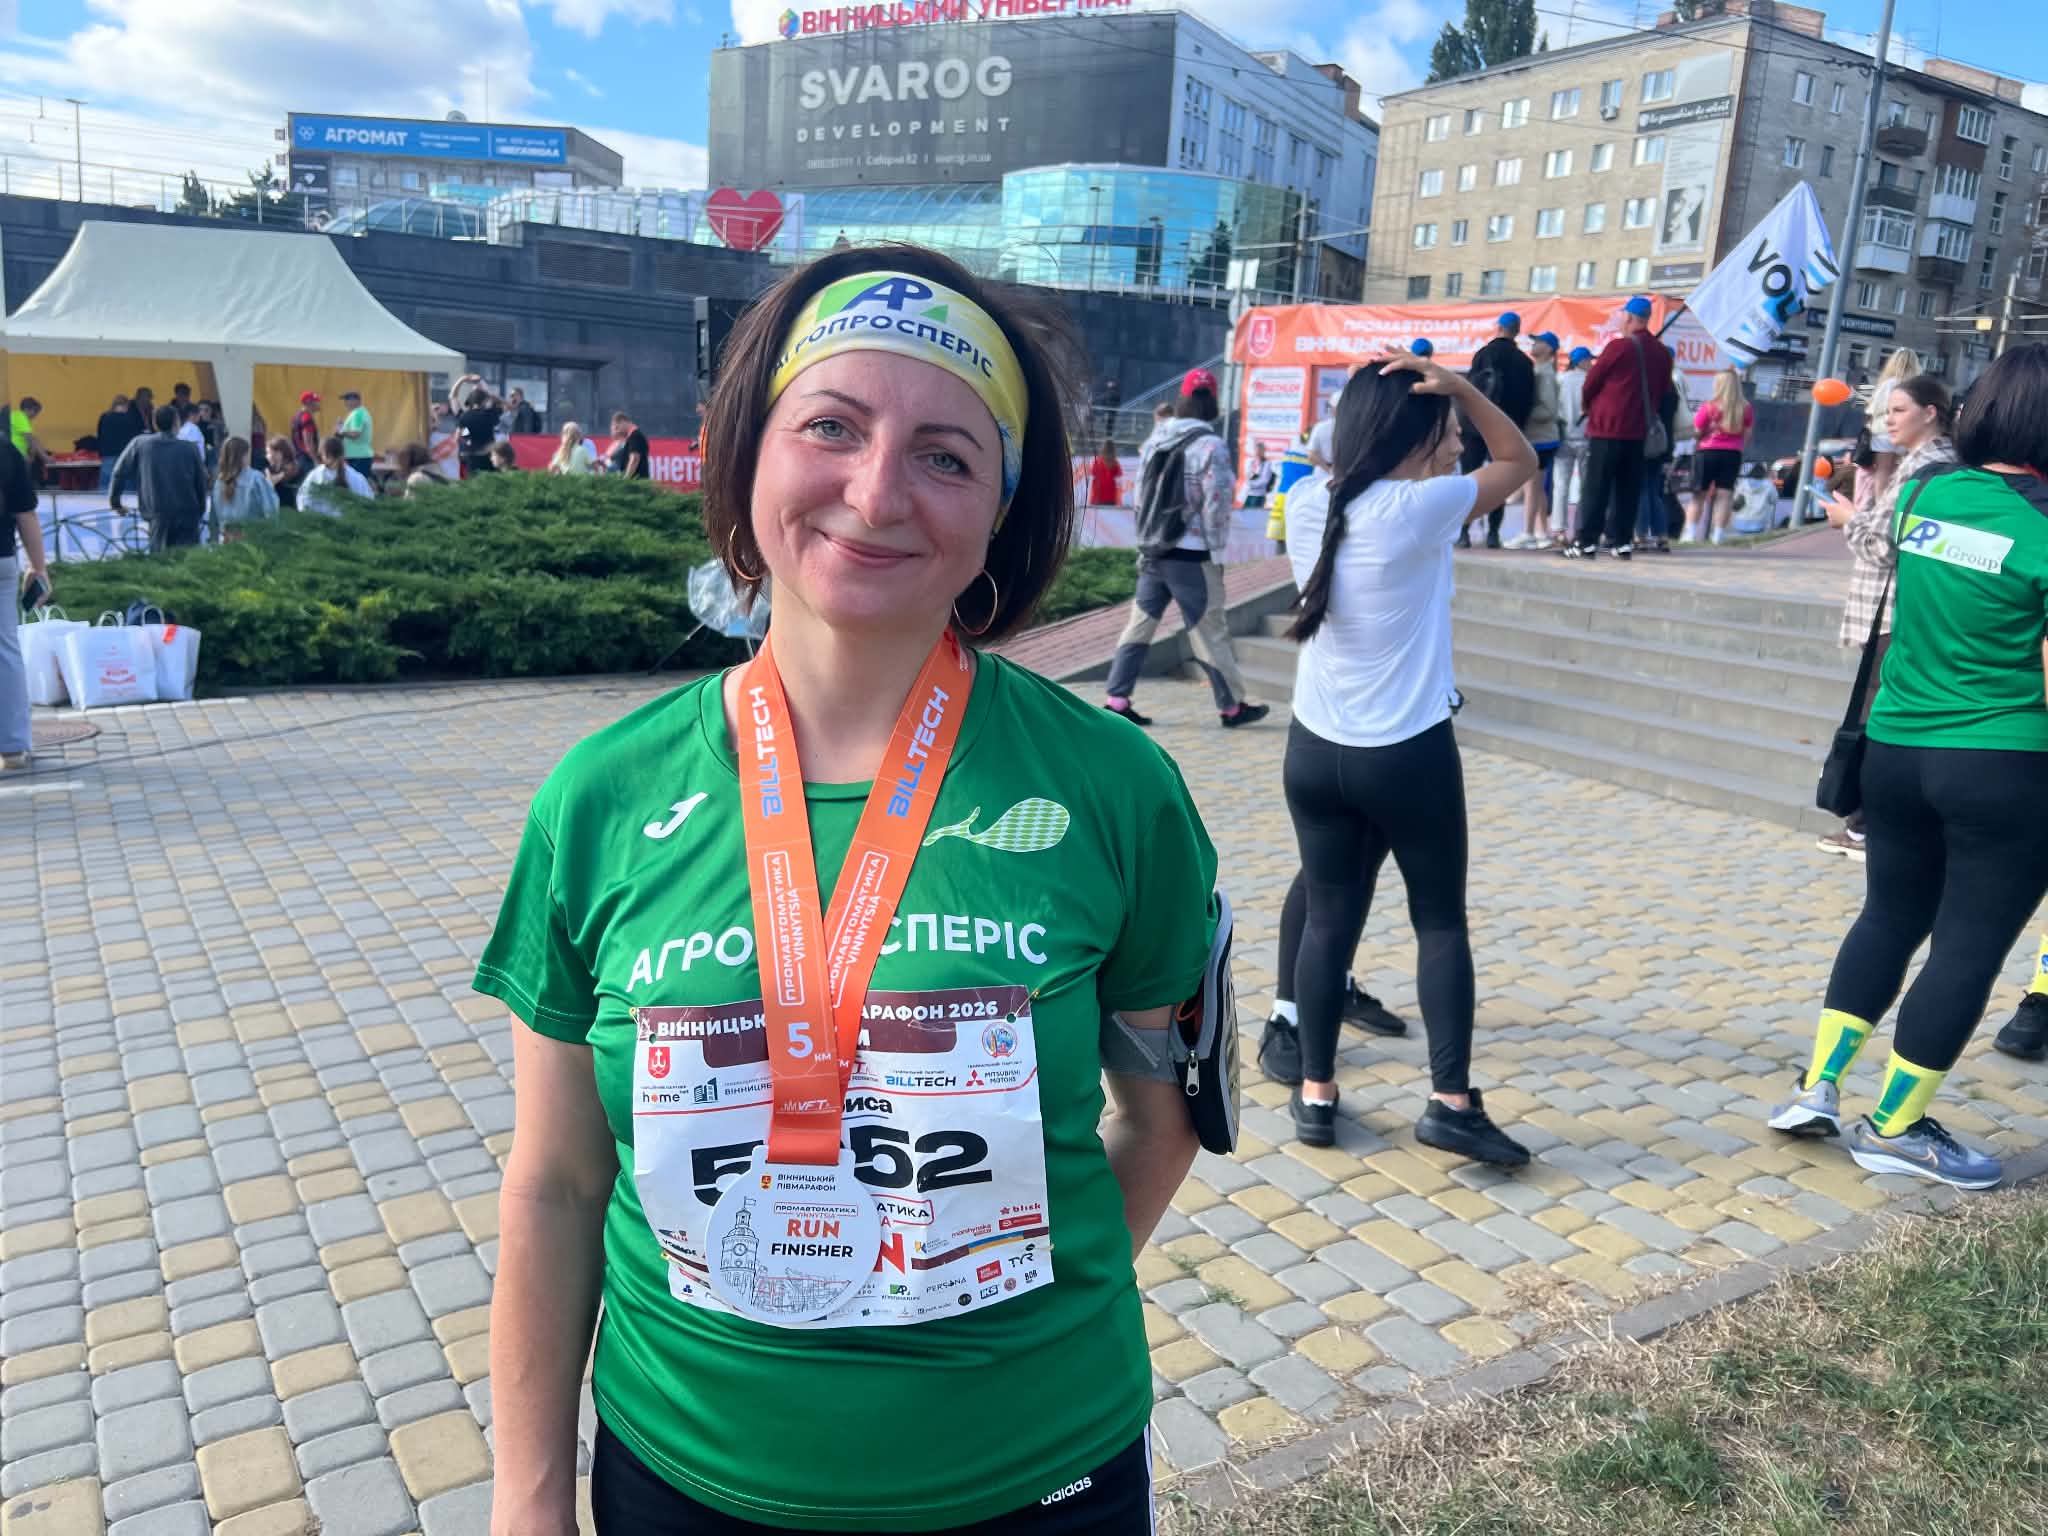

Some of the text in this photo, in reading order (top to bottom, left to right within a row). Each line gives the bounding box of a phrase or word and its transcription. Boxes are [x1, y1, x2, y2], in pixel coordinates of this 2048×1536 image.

[799, 56, 1013, 109] SVAROG
[324, 127, 409, 146] АГРОМАТ
[796, 117, 1010, 143] DEVELOPMENT
[1675, 338, 1718, 364] RUN
[1946, 544, 1999, 571] Group
[748, 685, 784, 820] BILLTECH
[885, 685, 951, 820] BILLTECH
[770, 856, 798, 1001] ПРОМАВТОМАТИКА
[785, 888, 807, 961] VINNYTSIA
[844, 895, 881, 965] VINNYTSIA
[948, 1000, 998, 1019] 2026
[786, 1021, 814, 1059] 5
[884, 1075, 957, 1088] BILLTECH
[776, 1182, 837, 1192] ПІВМАРАФОН
[777, 1173, 836, 1184] ВІННИЦЬКИЙ
[775, 1204, 857, 1214] ПРОМАВТОМАТИКА
[786, 1218, 841, 1239] RUN
[770, 1242, 854, 1258] FINISHER
